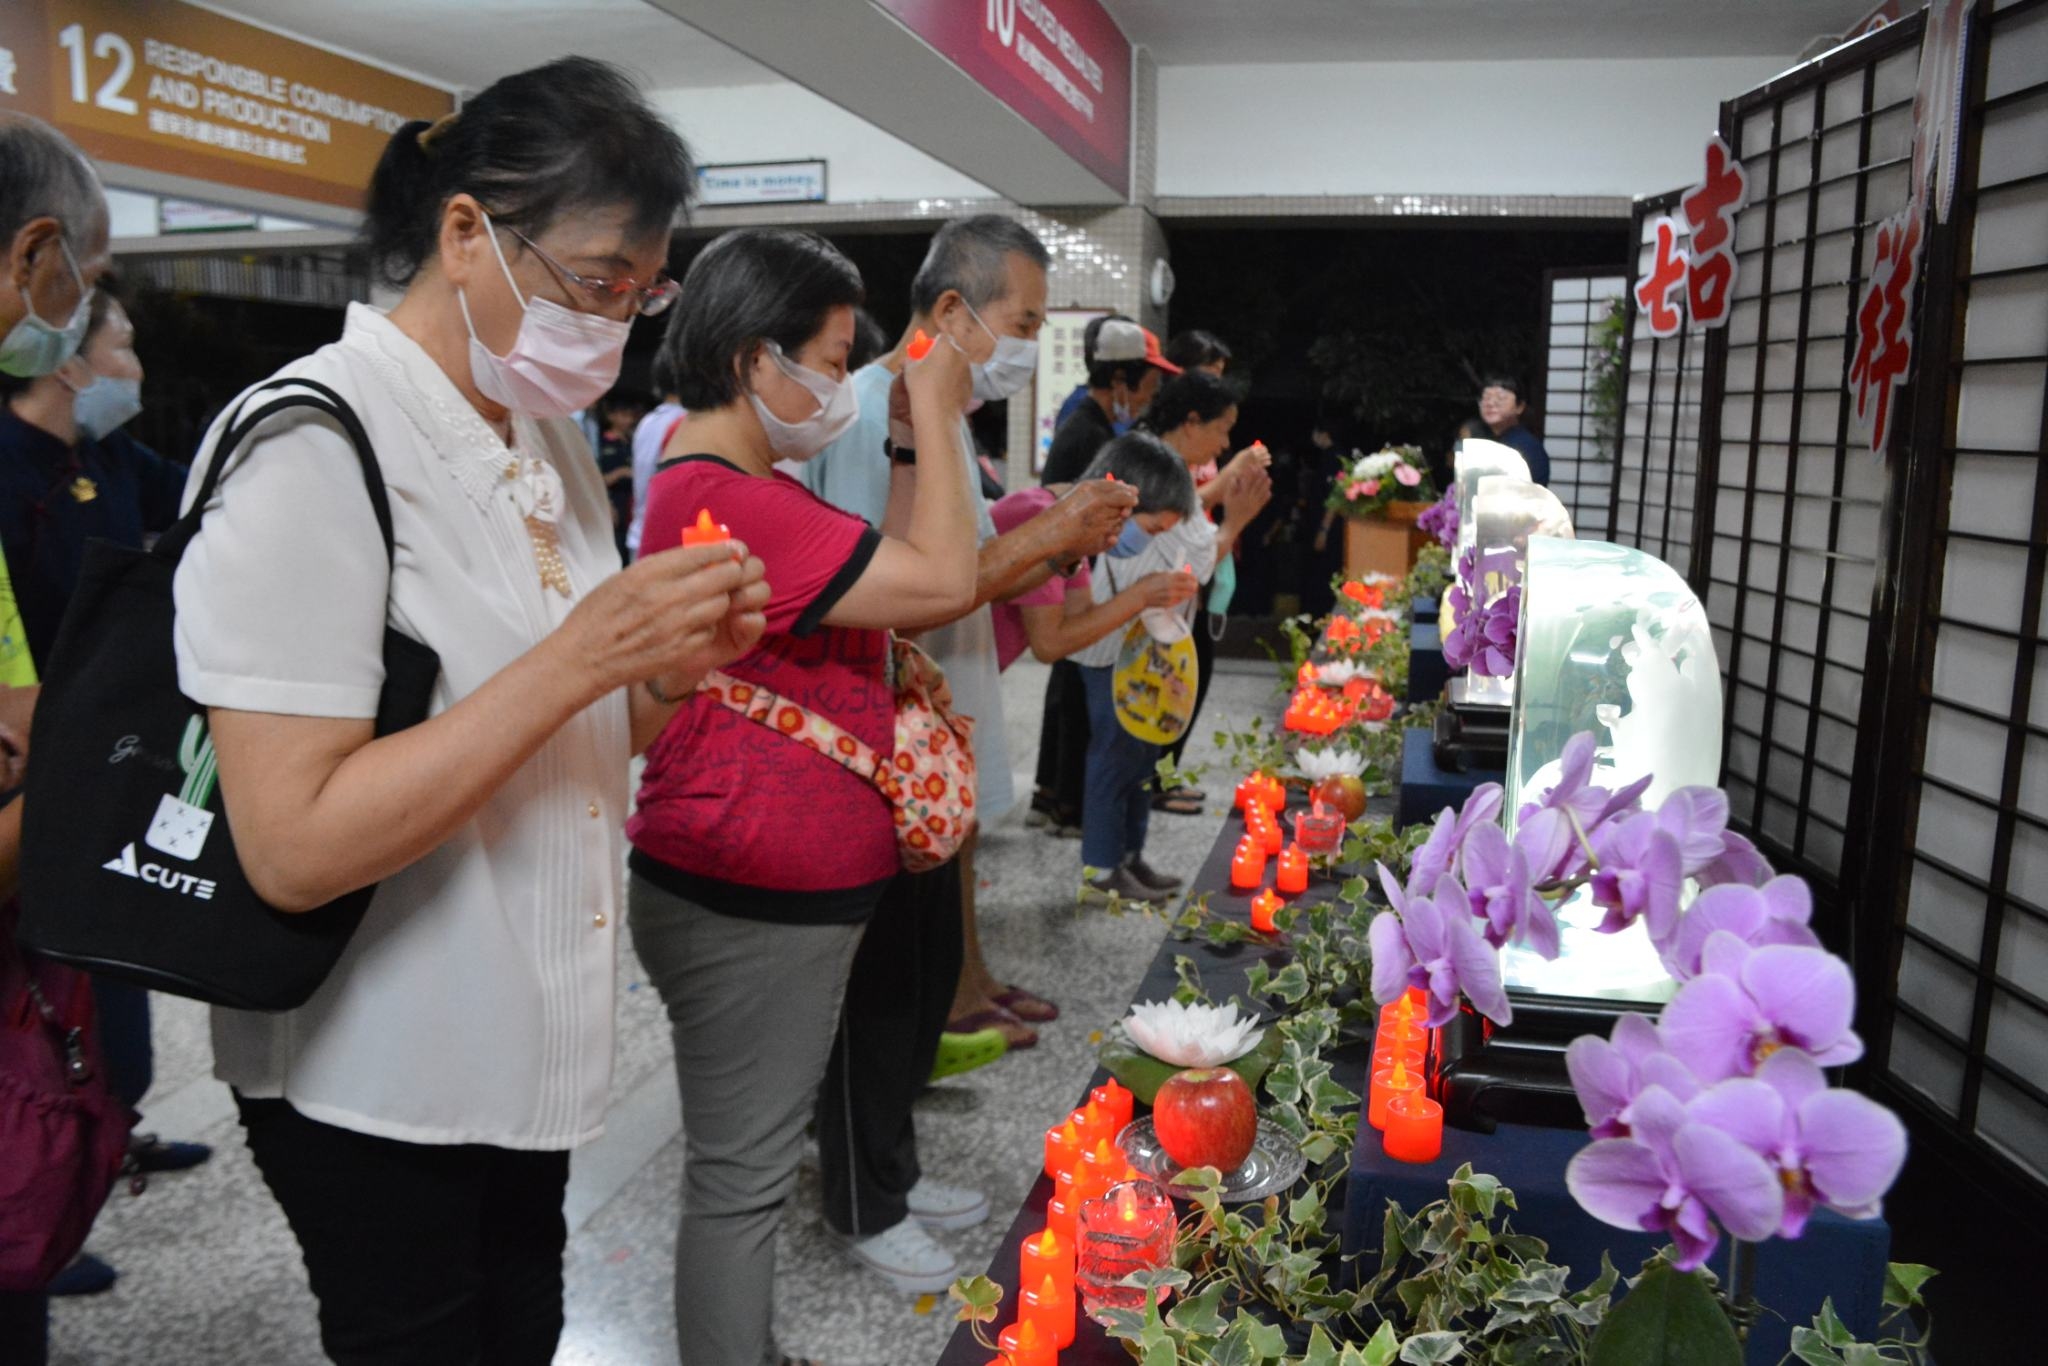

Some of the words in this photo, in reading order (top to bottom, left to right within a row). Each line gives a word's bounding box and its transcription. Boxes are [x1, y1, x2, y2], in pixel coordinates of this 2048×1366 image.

[58, 23, 139, 116] 12
[148, 74, 200, 109] AND
[202, 86, 331, 144] PRODUCTION
[101, 841, 217, 900] ACUTE
